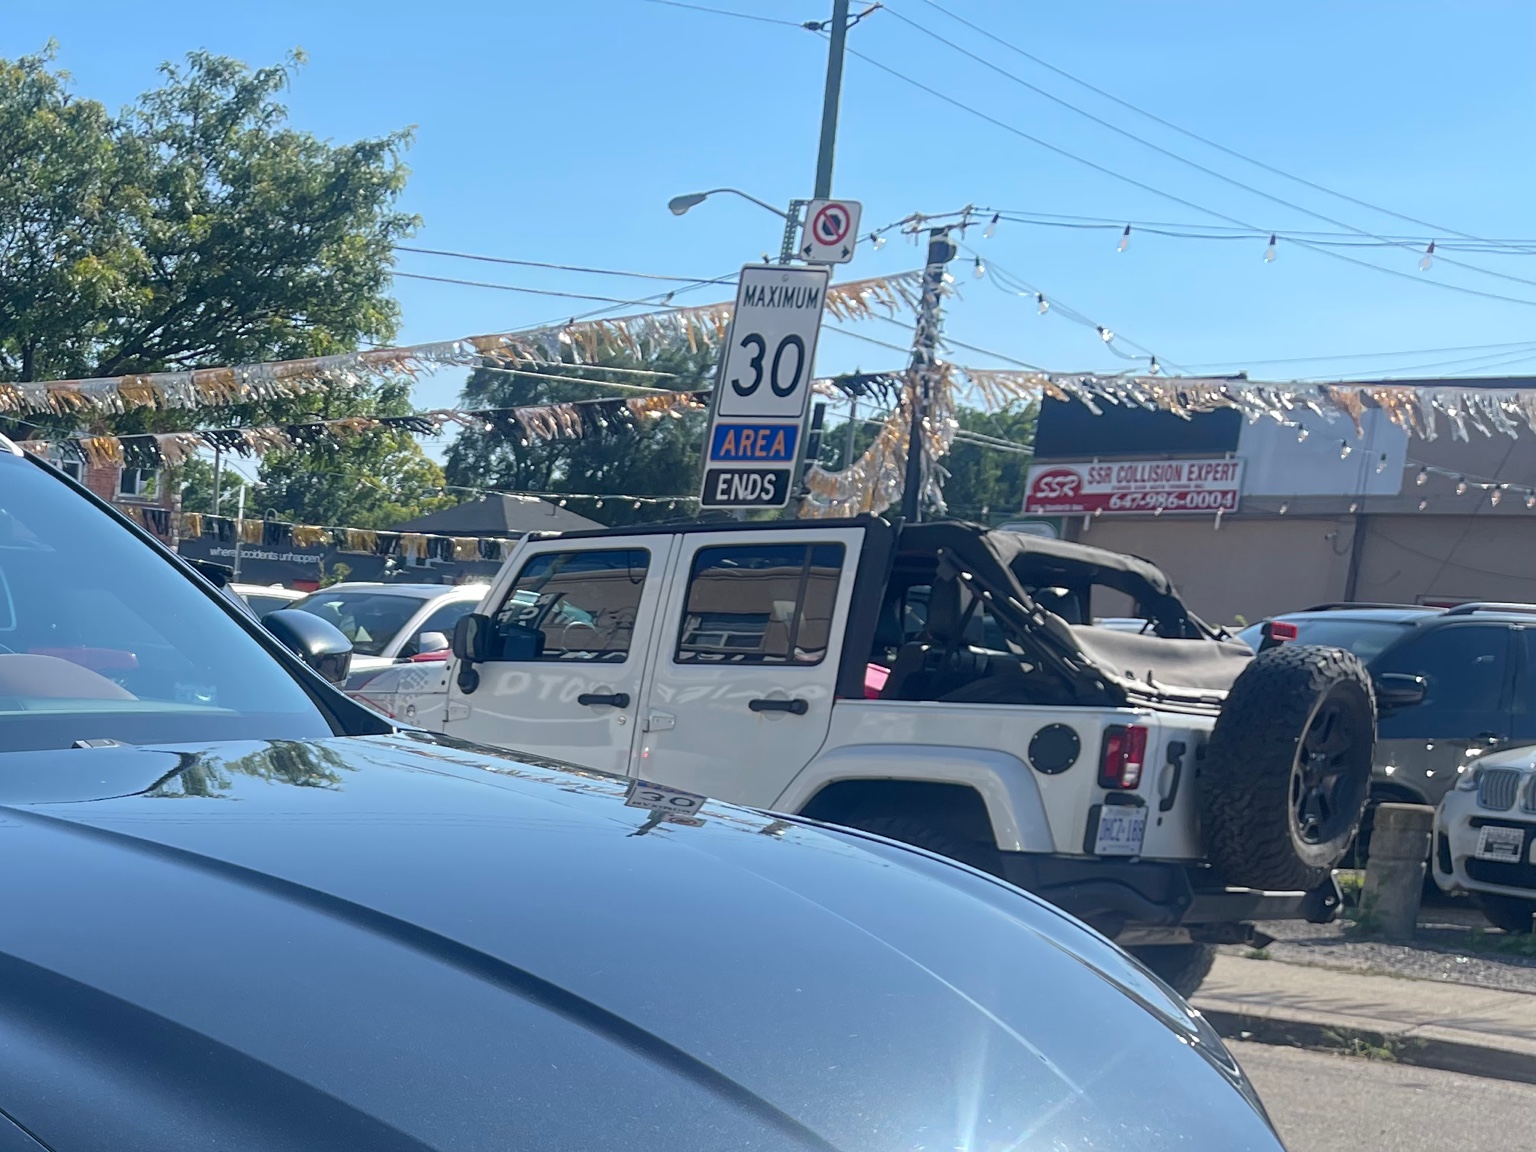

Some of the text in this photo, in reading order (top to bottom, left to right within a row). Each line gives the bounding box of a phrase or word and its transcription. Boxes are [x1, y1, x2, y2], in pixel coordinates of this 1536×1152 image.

[742, 285, 820, 309] MAXIMUM
[731, 333, 805, 397] 30
[719, 429, 786, 456] AREA
[1087, 462, 1239, 485] SSR COLLISION EXPERT
[716, 473, 777, 500] ENDS
[1035, 476, 1080, 498] SSR
[1109, 492, 1234, 509] 647-986-0004
[209, 547, 236, 557] where
[279, 551, 321, 564] unhappen
